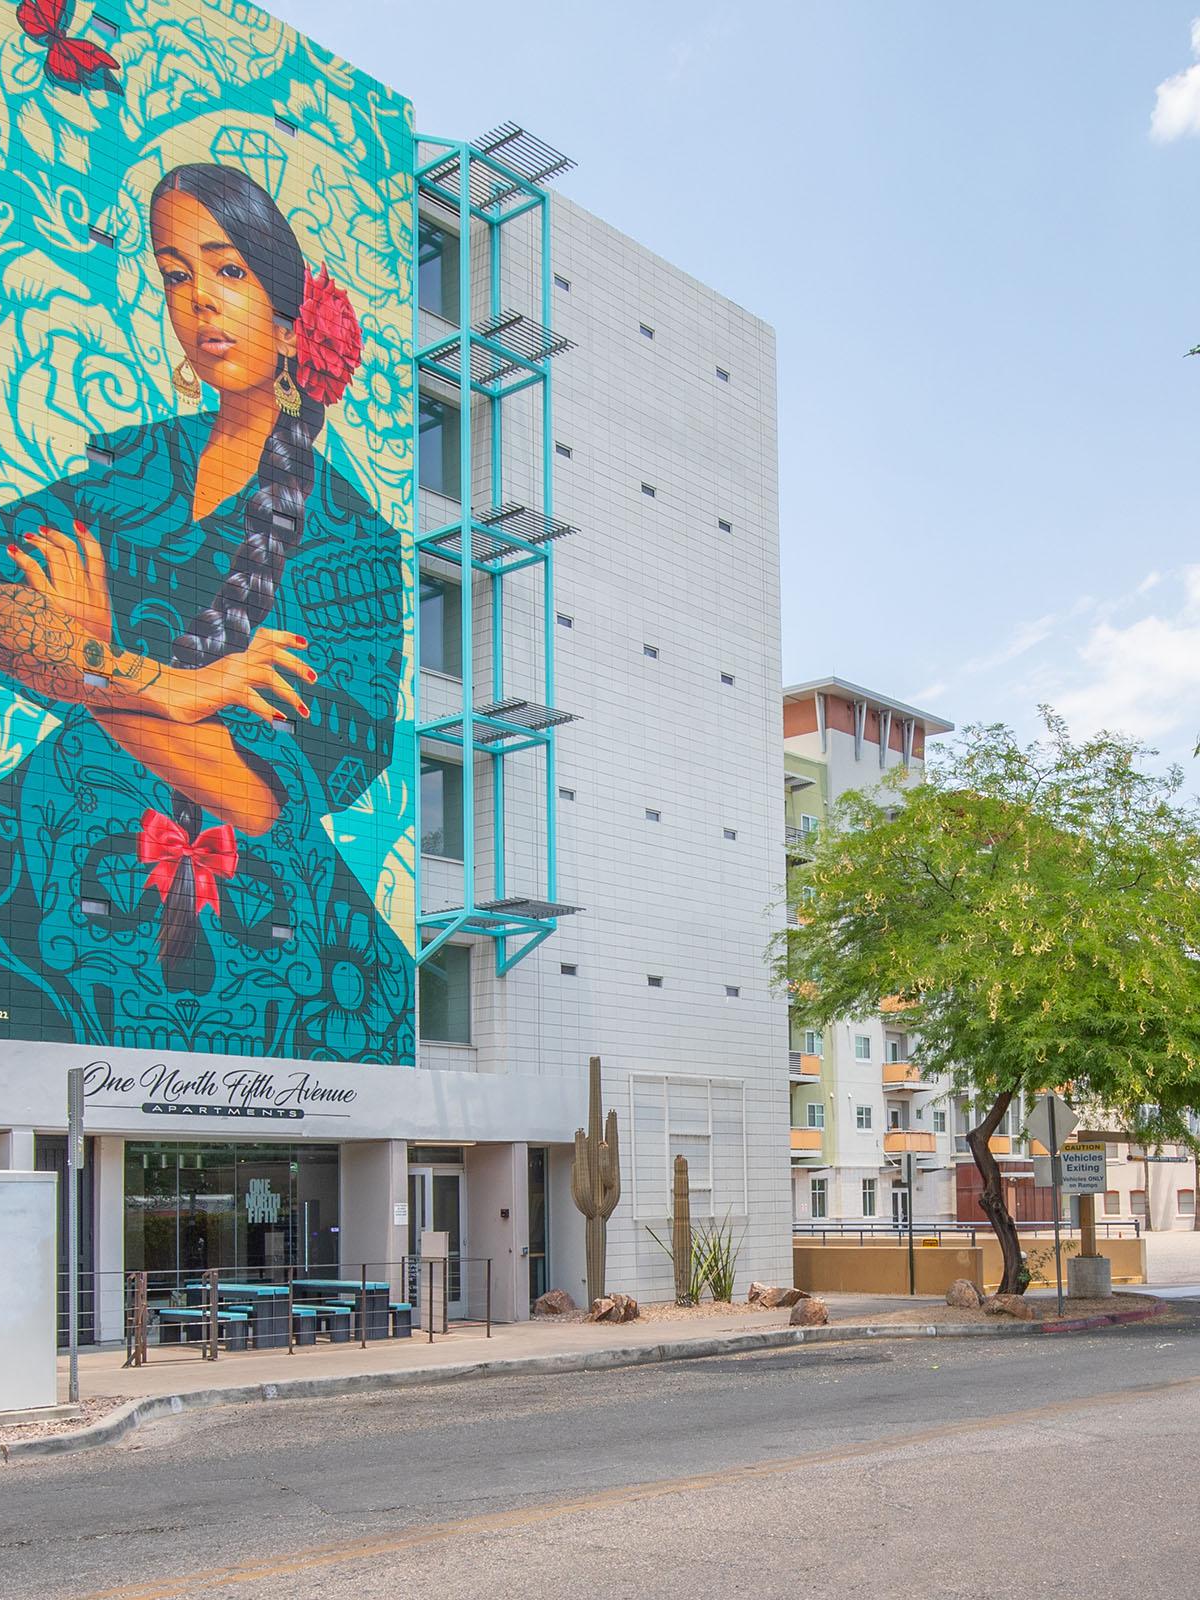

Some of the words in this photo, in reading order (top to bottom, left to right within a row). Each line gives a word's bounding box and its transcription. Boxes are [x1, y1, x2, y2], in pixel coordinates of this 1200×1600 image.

[84, 1060, 136, 1097] One
[140, 1063, 218, 1102] North
[222, 1068, 276, 1108] Fifth
[274, 1072, 357, 1106] Avenue
[152, 1105, 298, 1118] APARTMENTS
[1062, 1153, 1103, 1162] Vehicles
[1067, 1164, 1099, 1172] Exiting
[250, 1179, 271, 1194] ONE
[245, 1193, 280, 1209] NORTH
[248, 1208, 277, 1223] FIFTH
